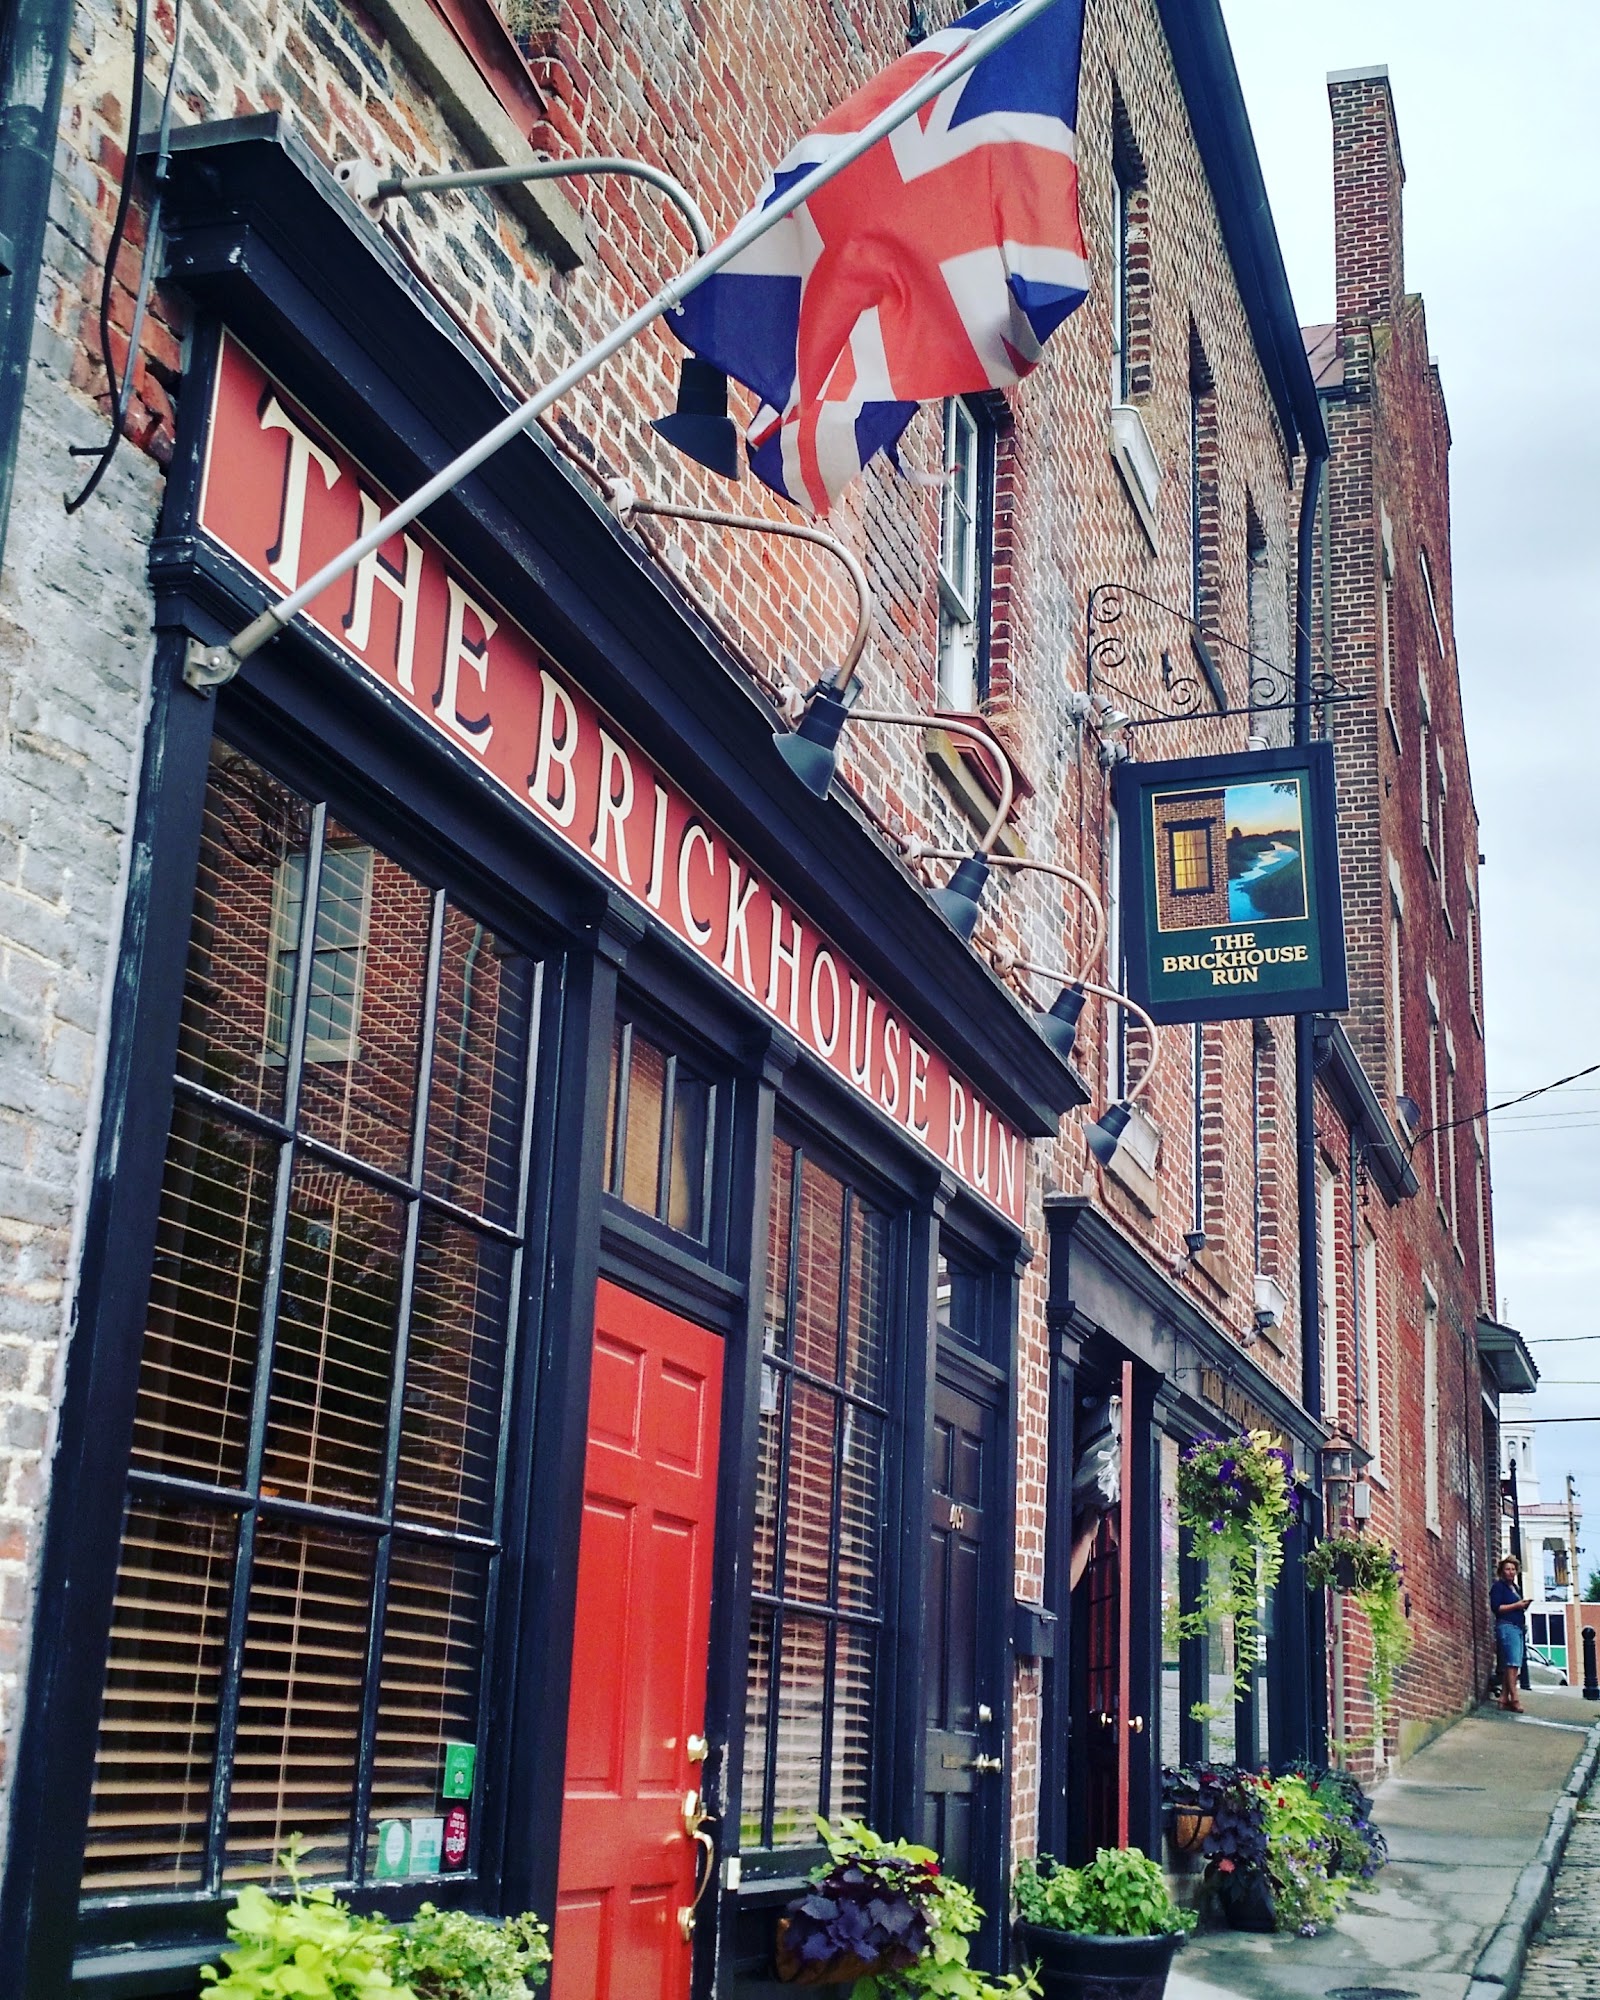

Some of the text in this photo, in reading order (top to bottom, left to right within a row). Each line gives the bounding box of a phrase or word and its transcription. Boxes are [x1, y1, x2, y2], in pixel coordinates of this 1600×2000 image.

[260, 396, 1018, 1216] THE BRICKHOUSE RUN
[1210, 932, 1257, 951] THE
[1162, 945, 1309, 973] BRICKHOUSE
[1211, 966, 1259, 986] RUN
